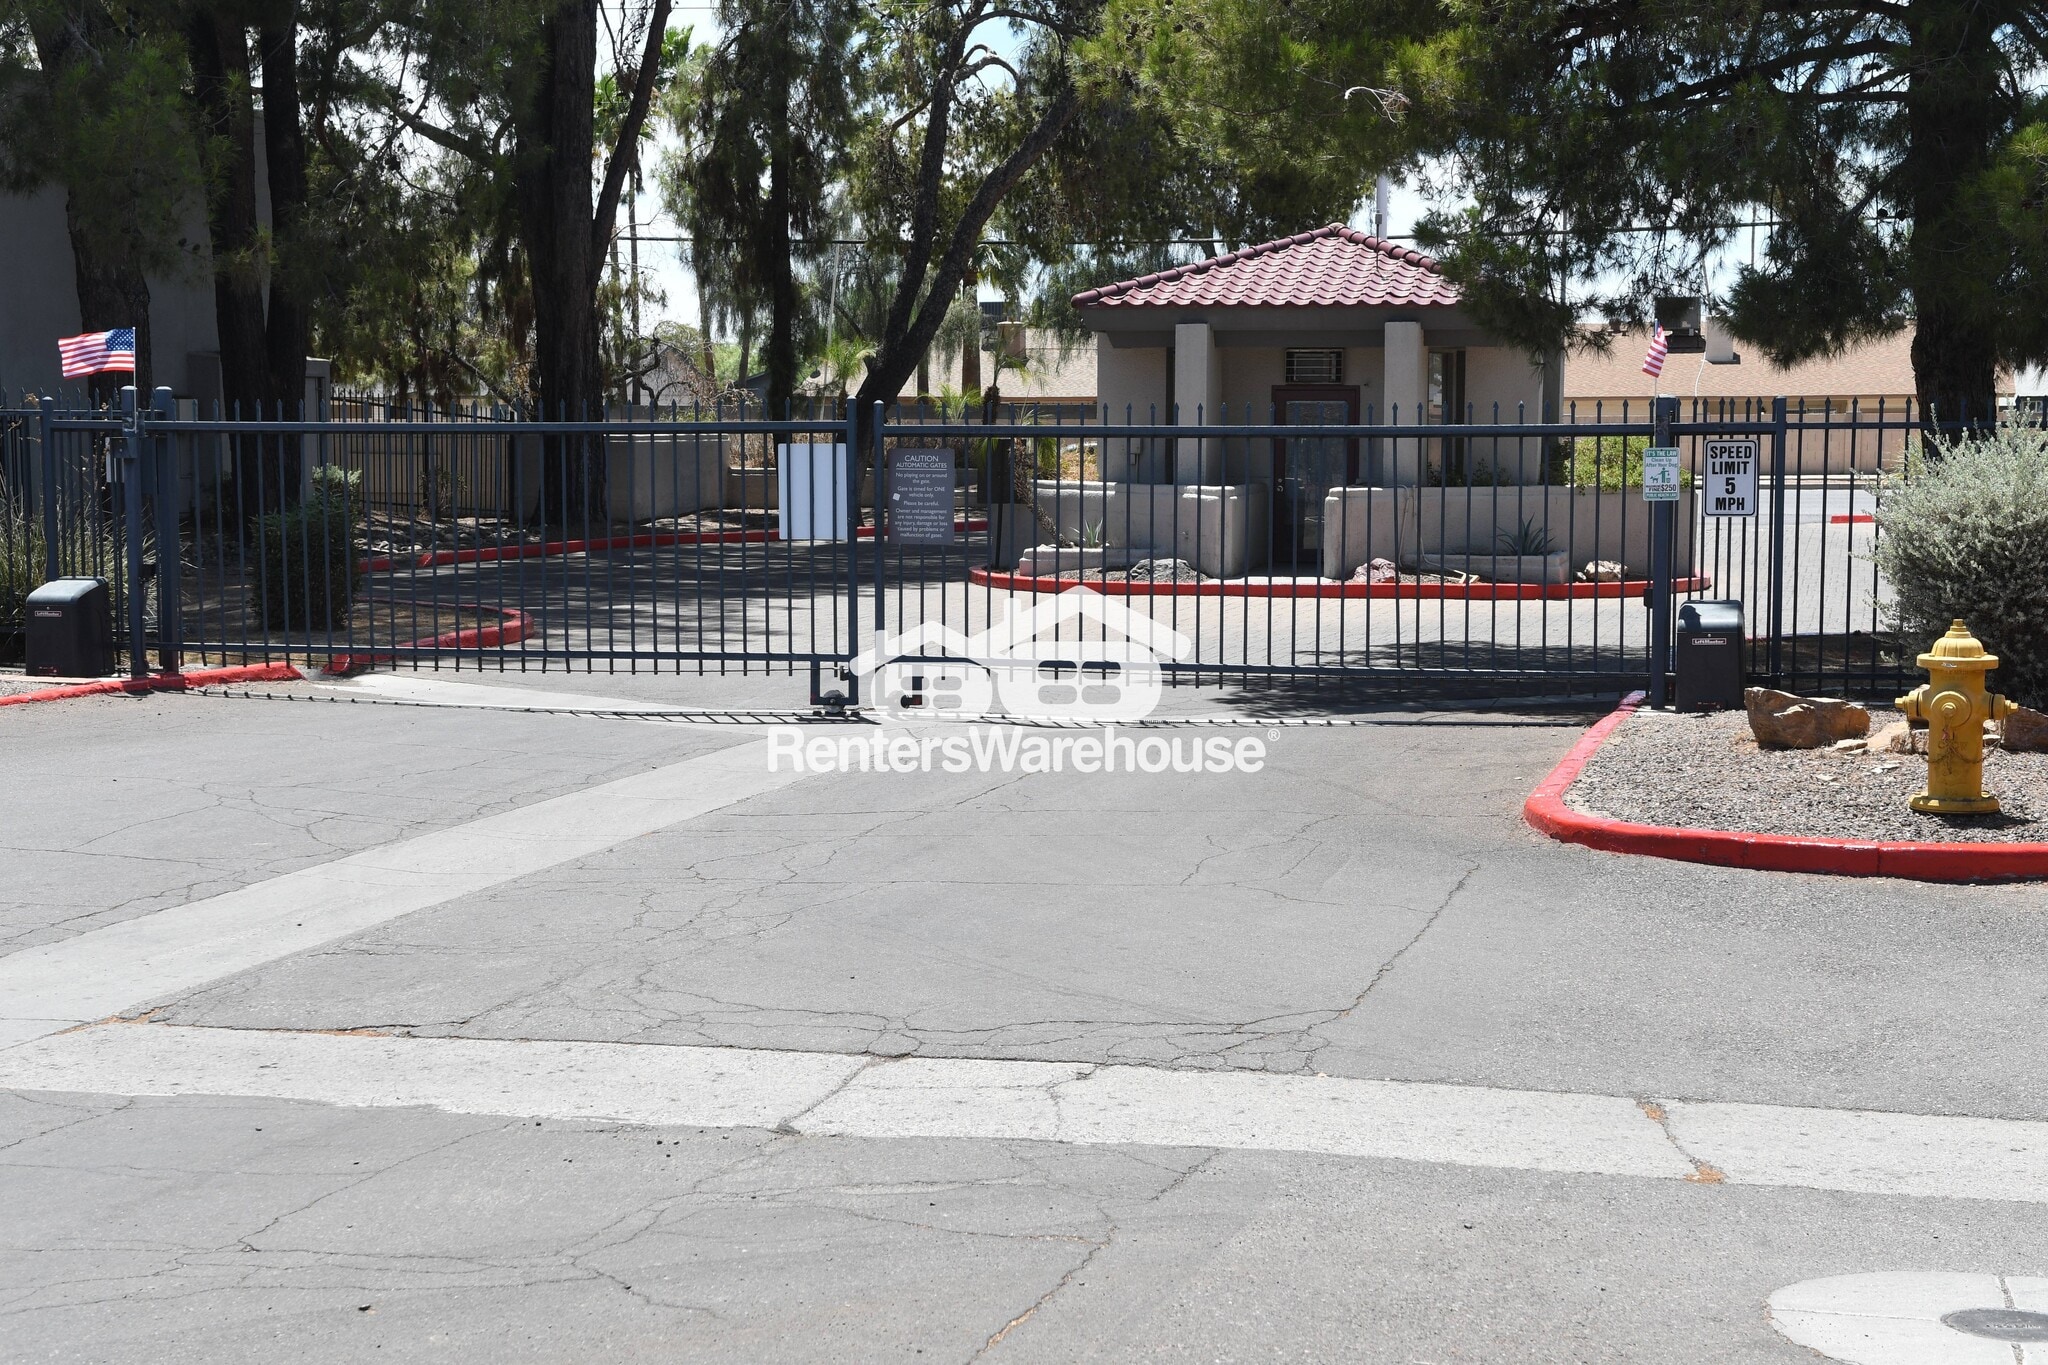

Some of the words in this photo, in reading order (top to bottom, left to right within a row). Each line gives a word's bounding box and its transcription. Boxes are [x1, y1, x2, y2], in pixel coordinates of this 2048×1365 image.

[1710, 446, 1752, 459] SPEED
[1712, 461, 1750, 475] LIMIT
[1725, 477, 1736, 494] 5
[1715, 497, 1745, 511] MPH
